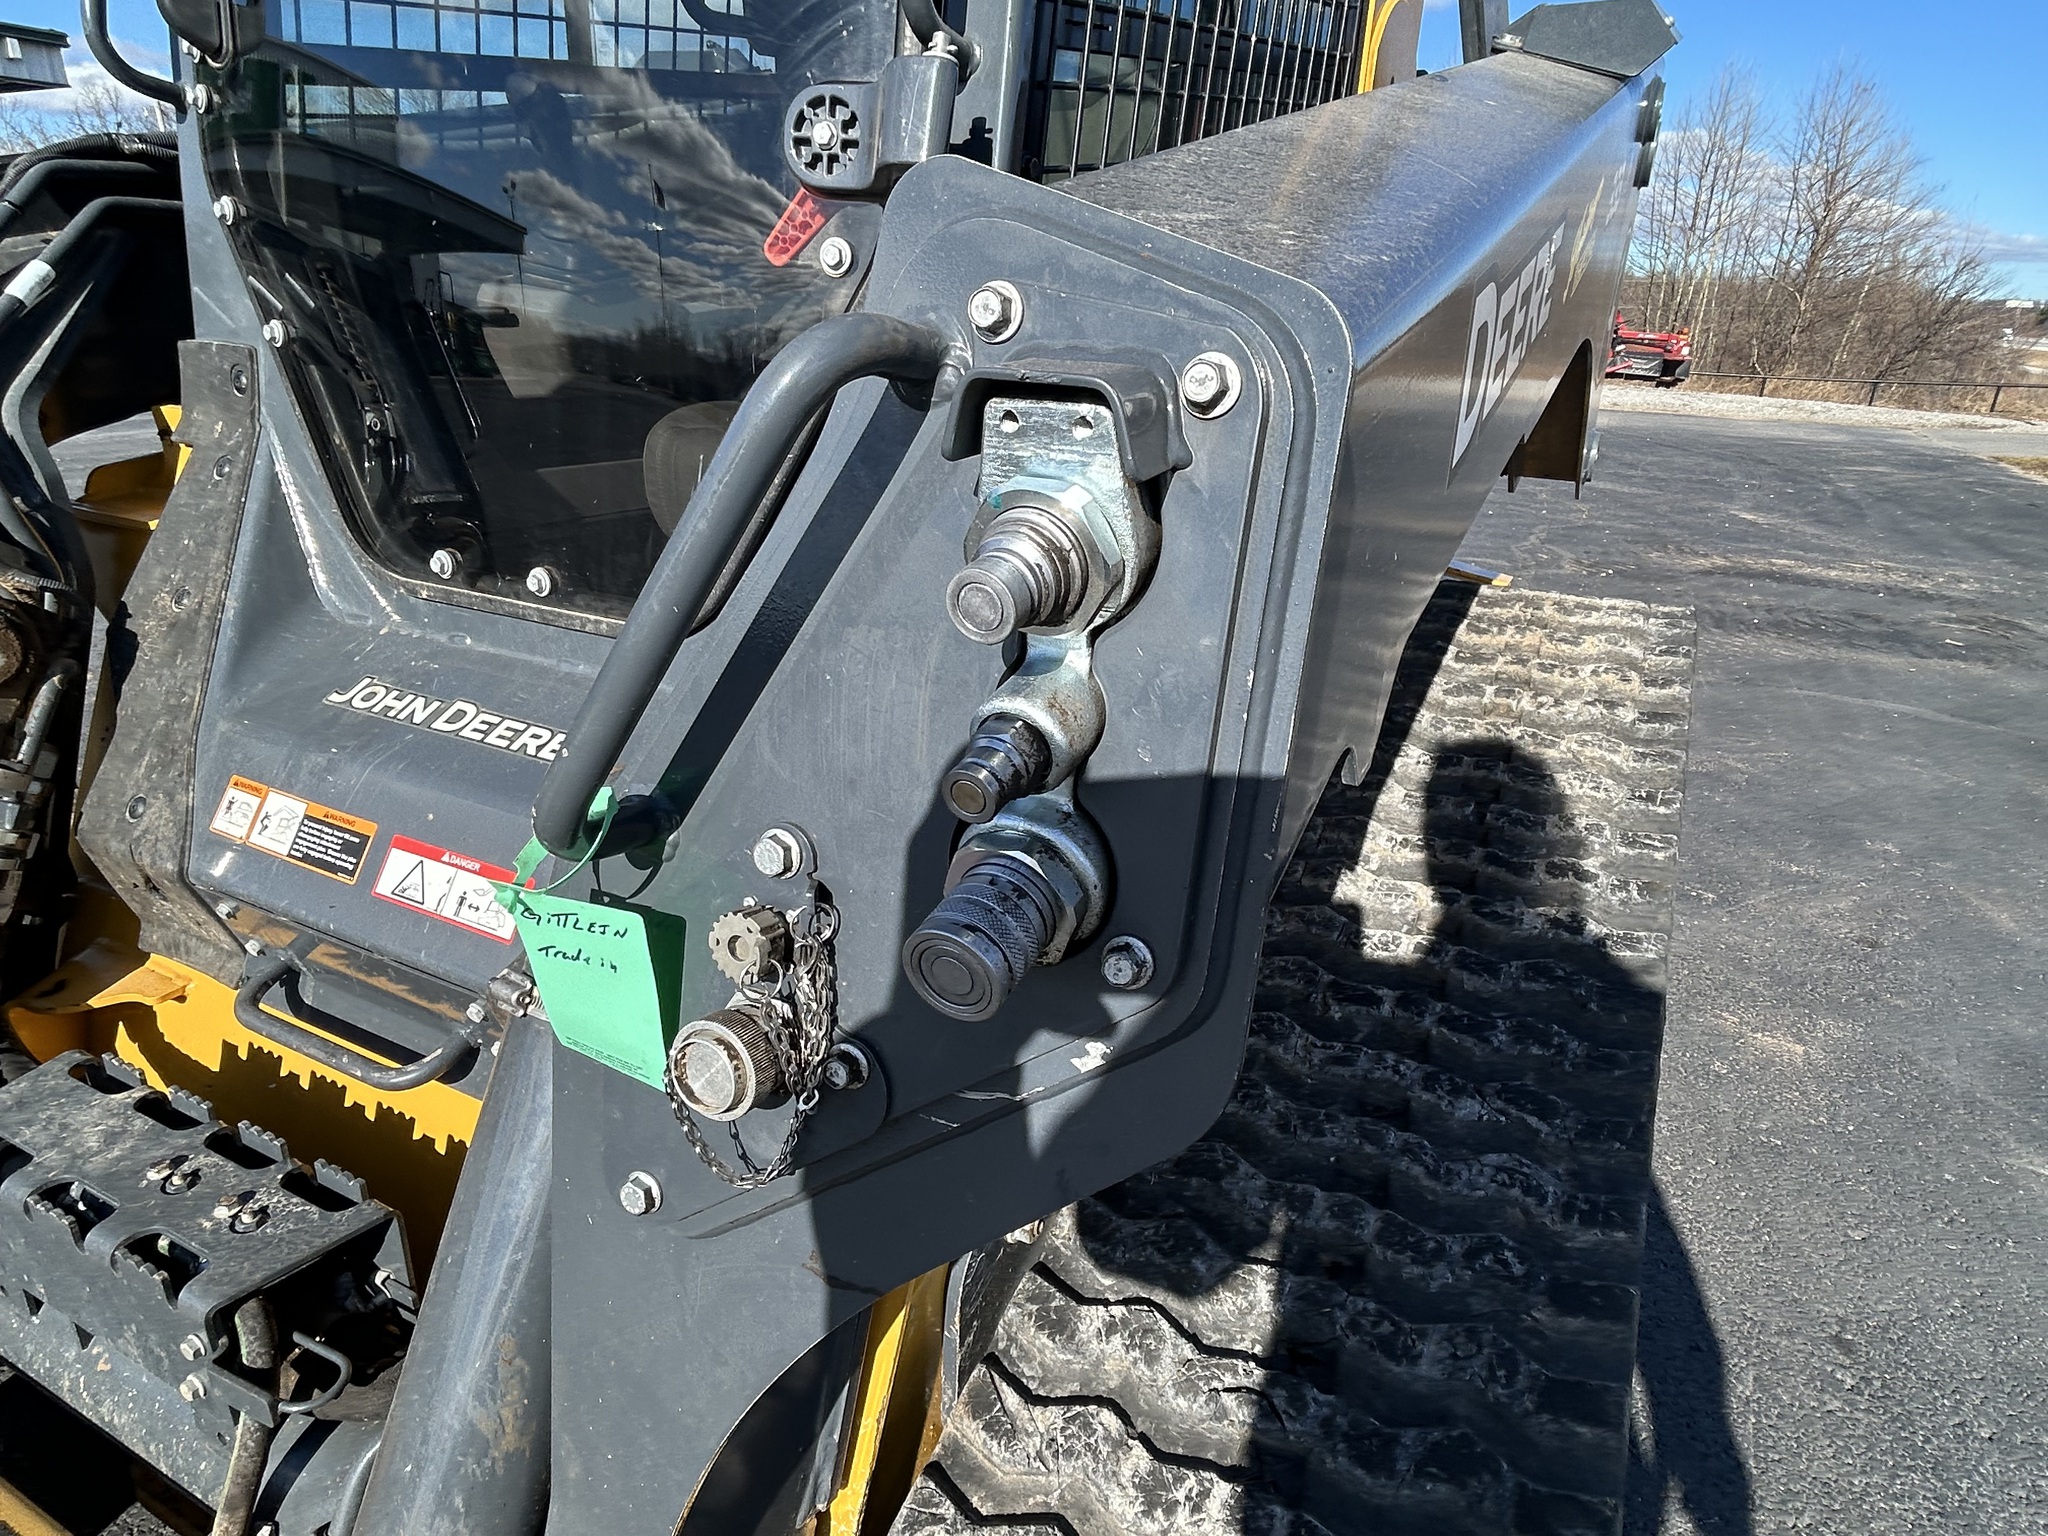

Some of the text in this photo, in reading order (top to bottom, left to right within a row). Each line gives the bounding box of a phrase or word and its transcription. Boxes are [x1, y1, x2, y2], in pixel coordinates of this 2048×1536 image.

[1451, 221, 1566, 469] DEERE
[326, 677, 442, 725] JOHN
[328, 812, 357, 828] WARNING
[449, 856, 481, 872] DANGER
[537, 945, 591, 966] Trade
